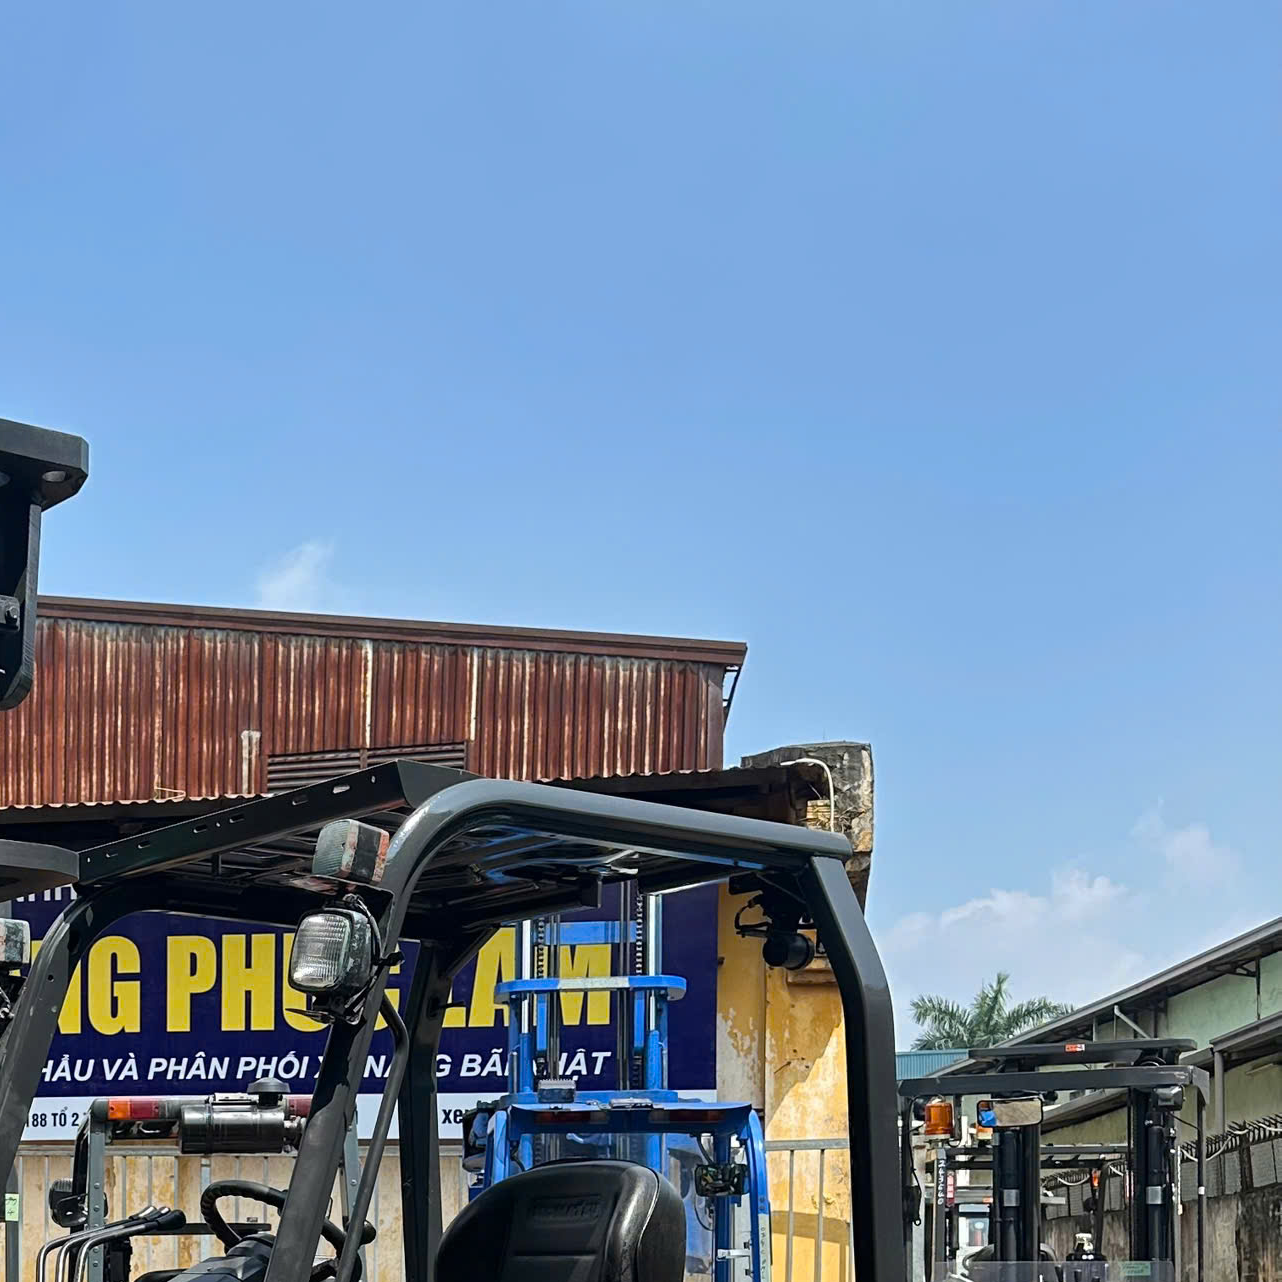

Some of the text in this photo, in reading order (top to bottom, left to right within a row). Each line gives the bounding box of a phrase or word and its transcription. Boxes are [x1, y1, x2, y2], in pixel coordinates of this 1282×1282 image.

[102, 1052, 139, 1080] VÀ
[147, 1051, 229, 1080] PHÂN
[237, 1050, 309, 1080] PHỐI
[51, 1106, 67, 1127] TỔ
[71, 1113, 79, 1126] 2
